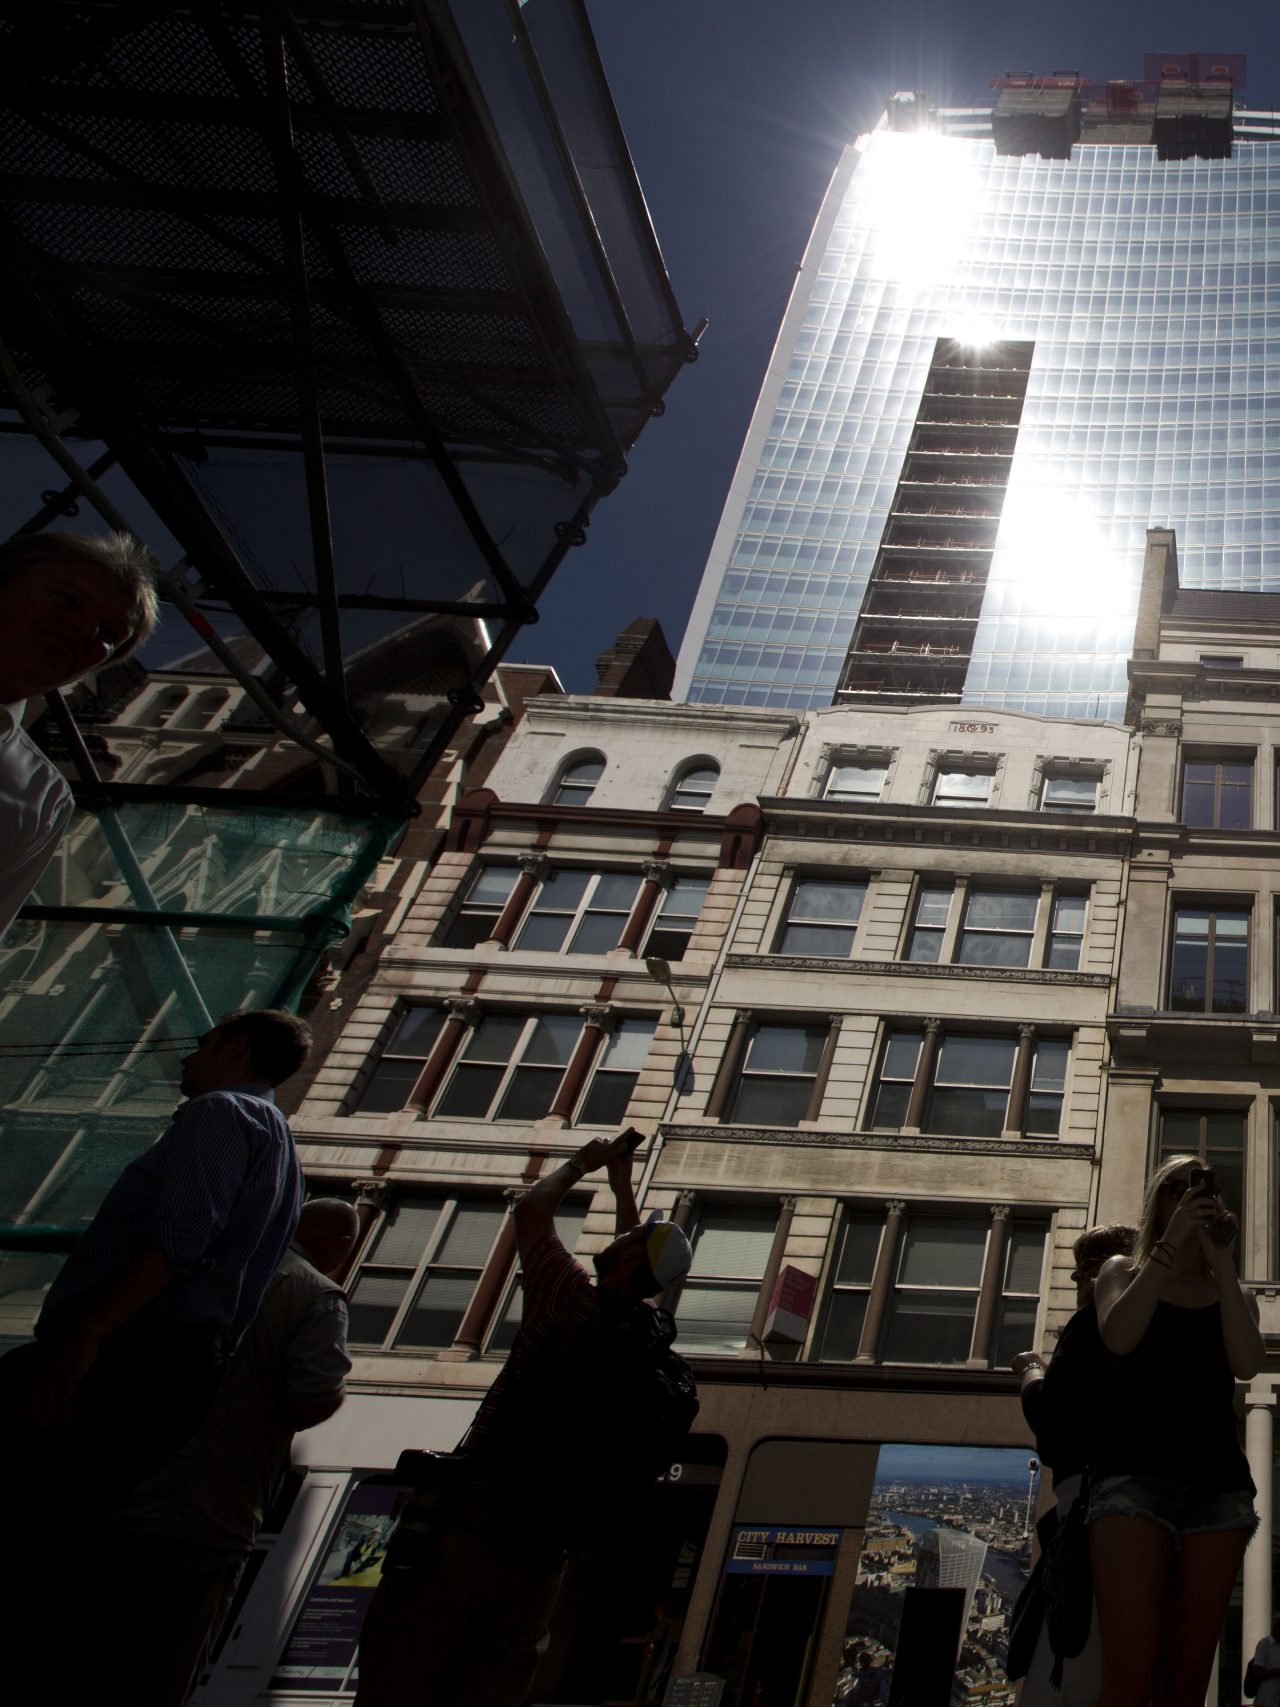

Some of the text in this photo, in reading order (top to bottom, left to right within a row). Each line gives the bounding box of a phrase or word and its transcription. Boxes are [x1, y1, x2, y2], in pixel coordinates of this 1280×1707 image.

[737, 1530, 839, 1545] CITY HARVEST
[752, 1562, 808, 1572] SANDWICH BAR
